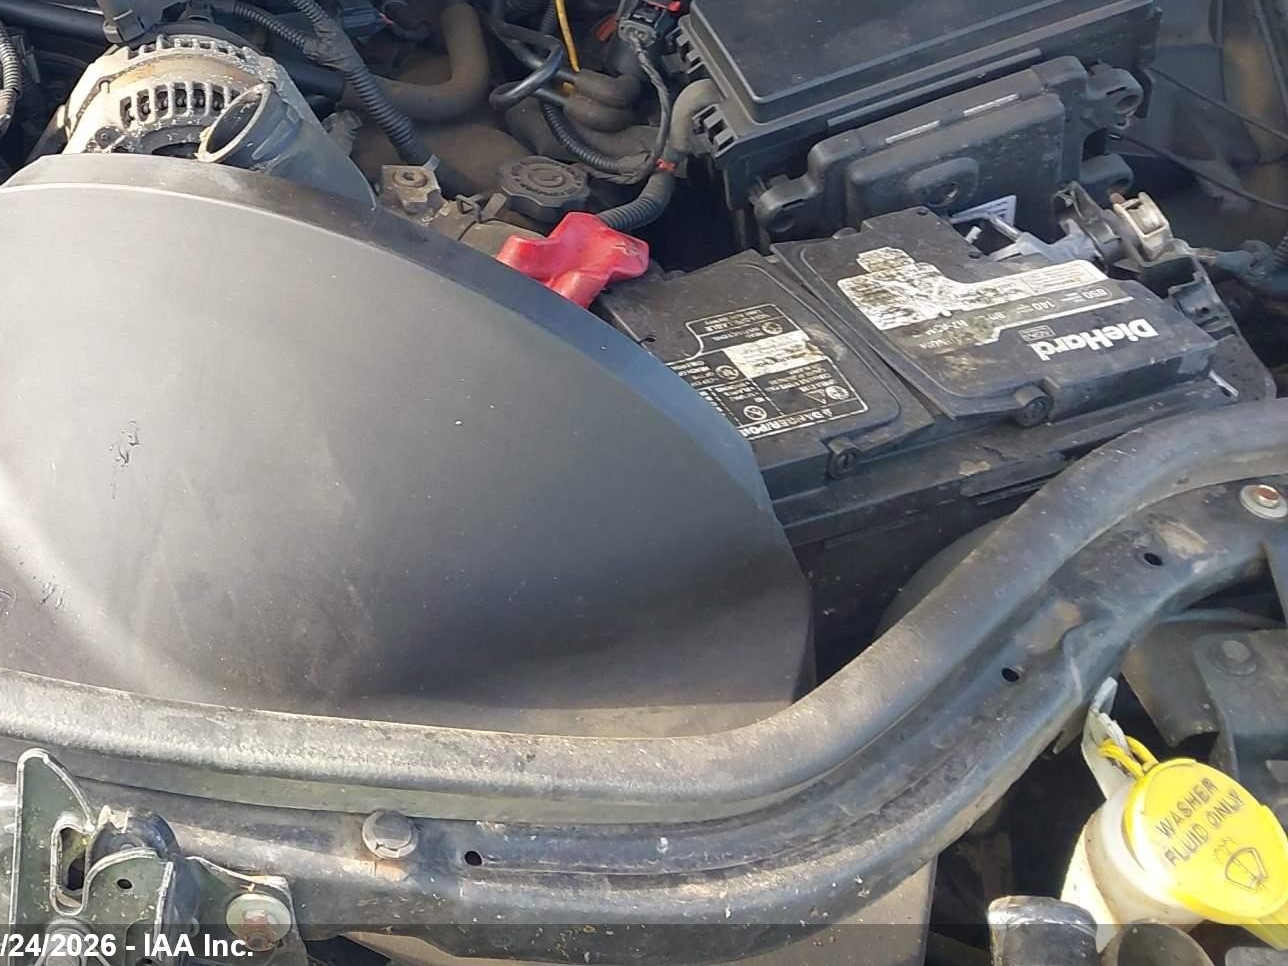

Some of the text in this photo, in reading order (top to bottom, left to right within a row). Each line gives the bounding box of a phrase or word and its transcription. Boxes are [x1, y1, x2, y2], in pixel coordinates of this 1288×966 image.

[1029, 318, 1161, 361] DieHard
[1155, 777, 1218, 838] WASHER
[1164, 788, 1245, 867] FLUID ONLY
